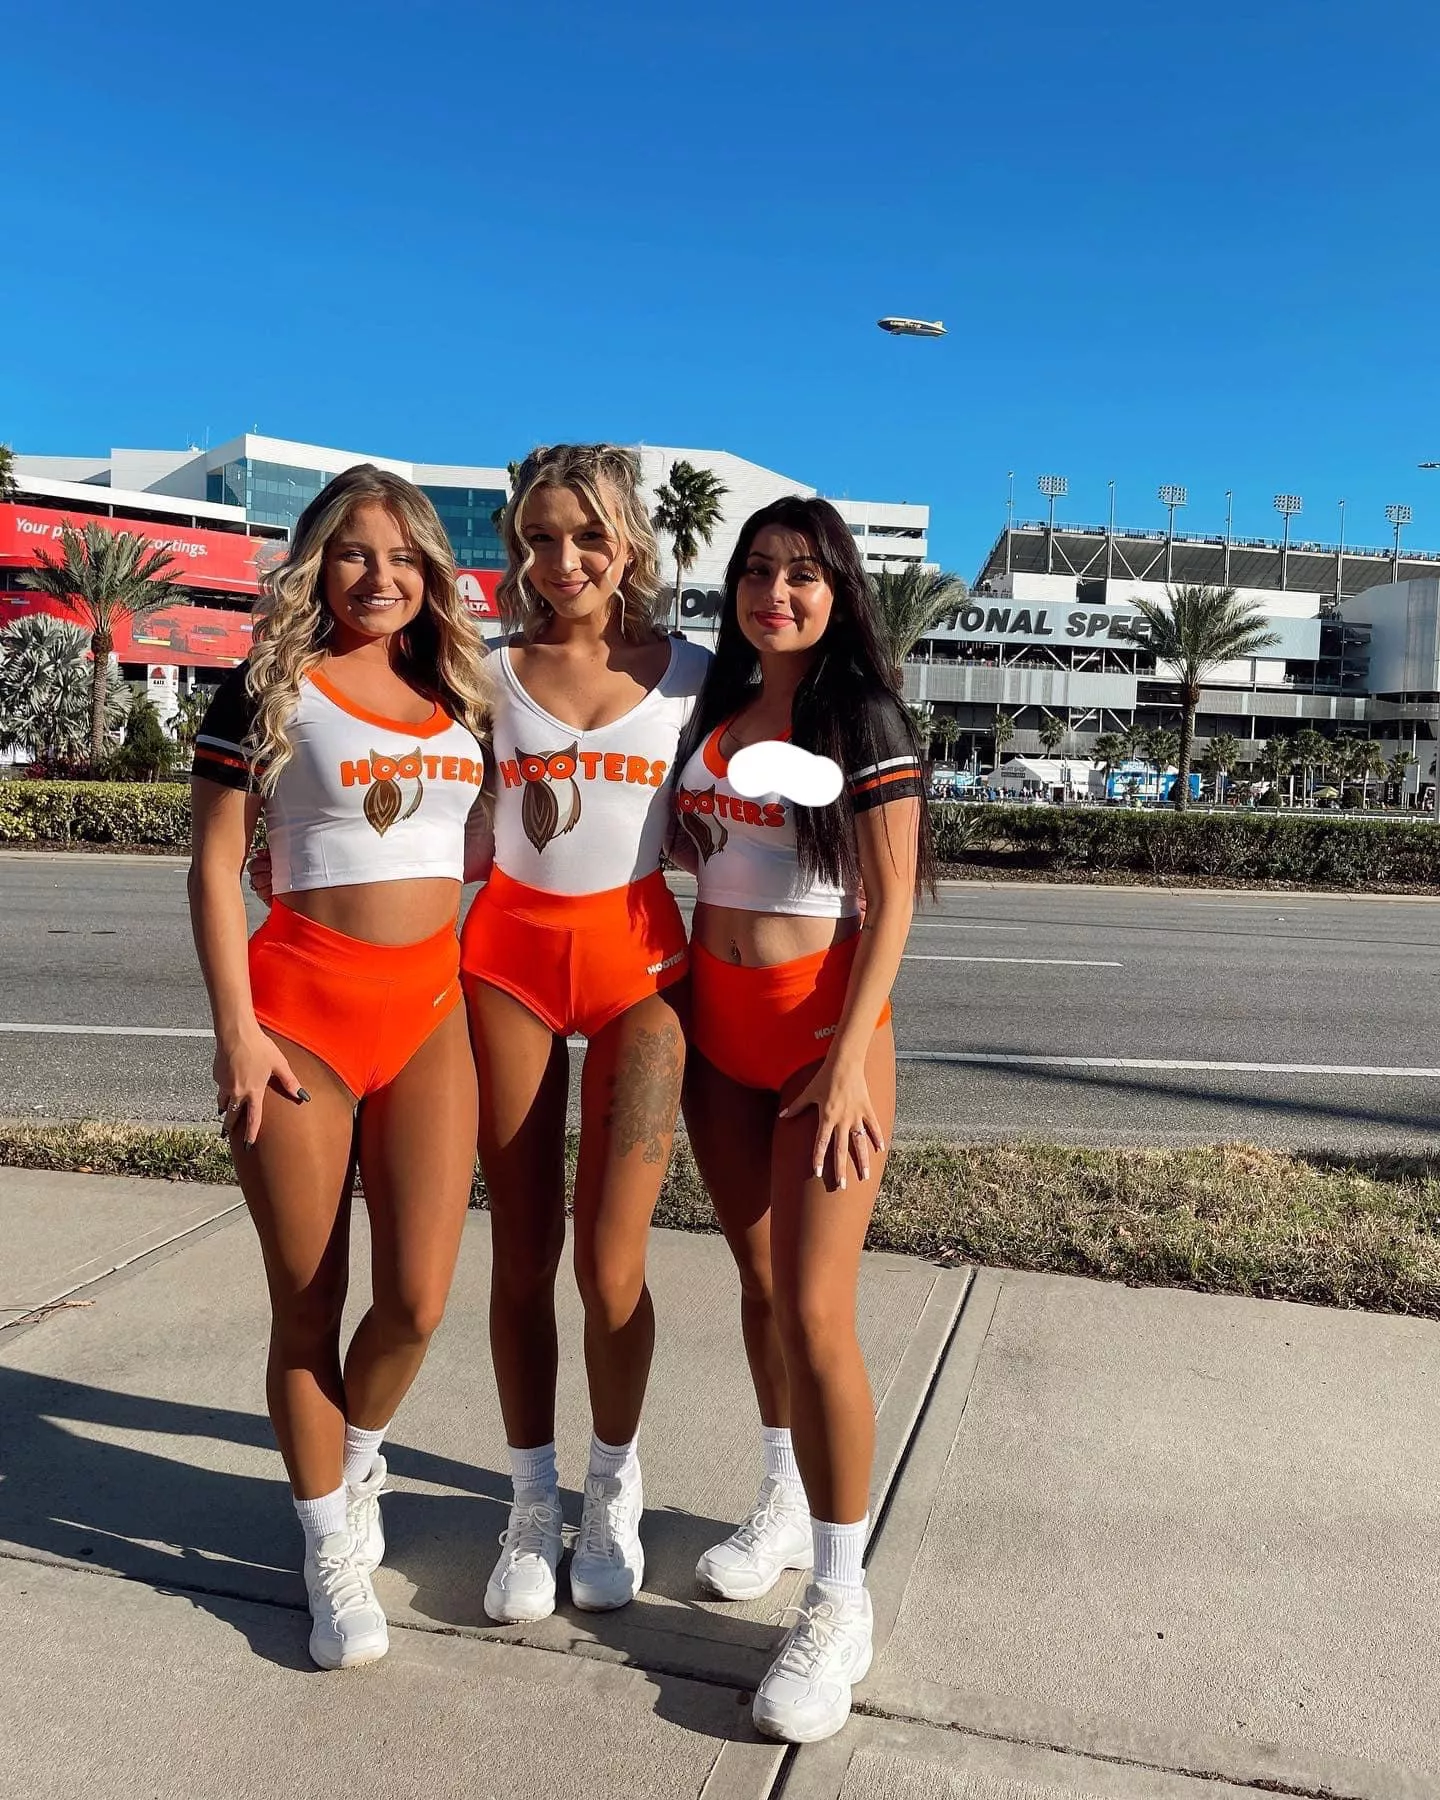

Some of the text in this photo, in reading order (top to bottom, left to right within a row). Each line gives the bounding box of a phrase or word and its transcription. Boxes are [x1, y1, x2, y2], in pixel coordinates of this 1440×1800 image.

[16, 517, 50, 535] Your
[340, 755, 483, 787] HOOTERS
[499, 751, 667, 789] HOOTERS
[676, 790, 786, 828] OOTERS
